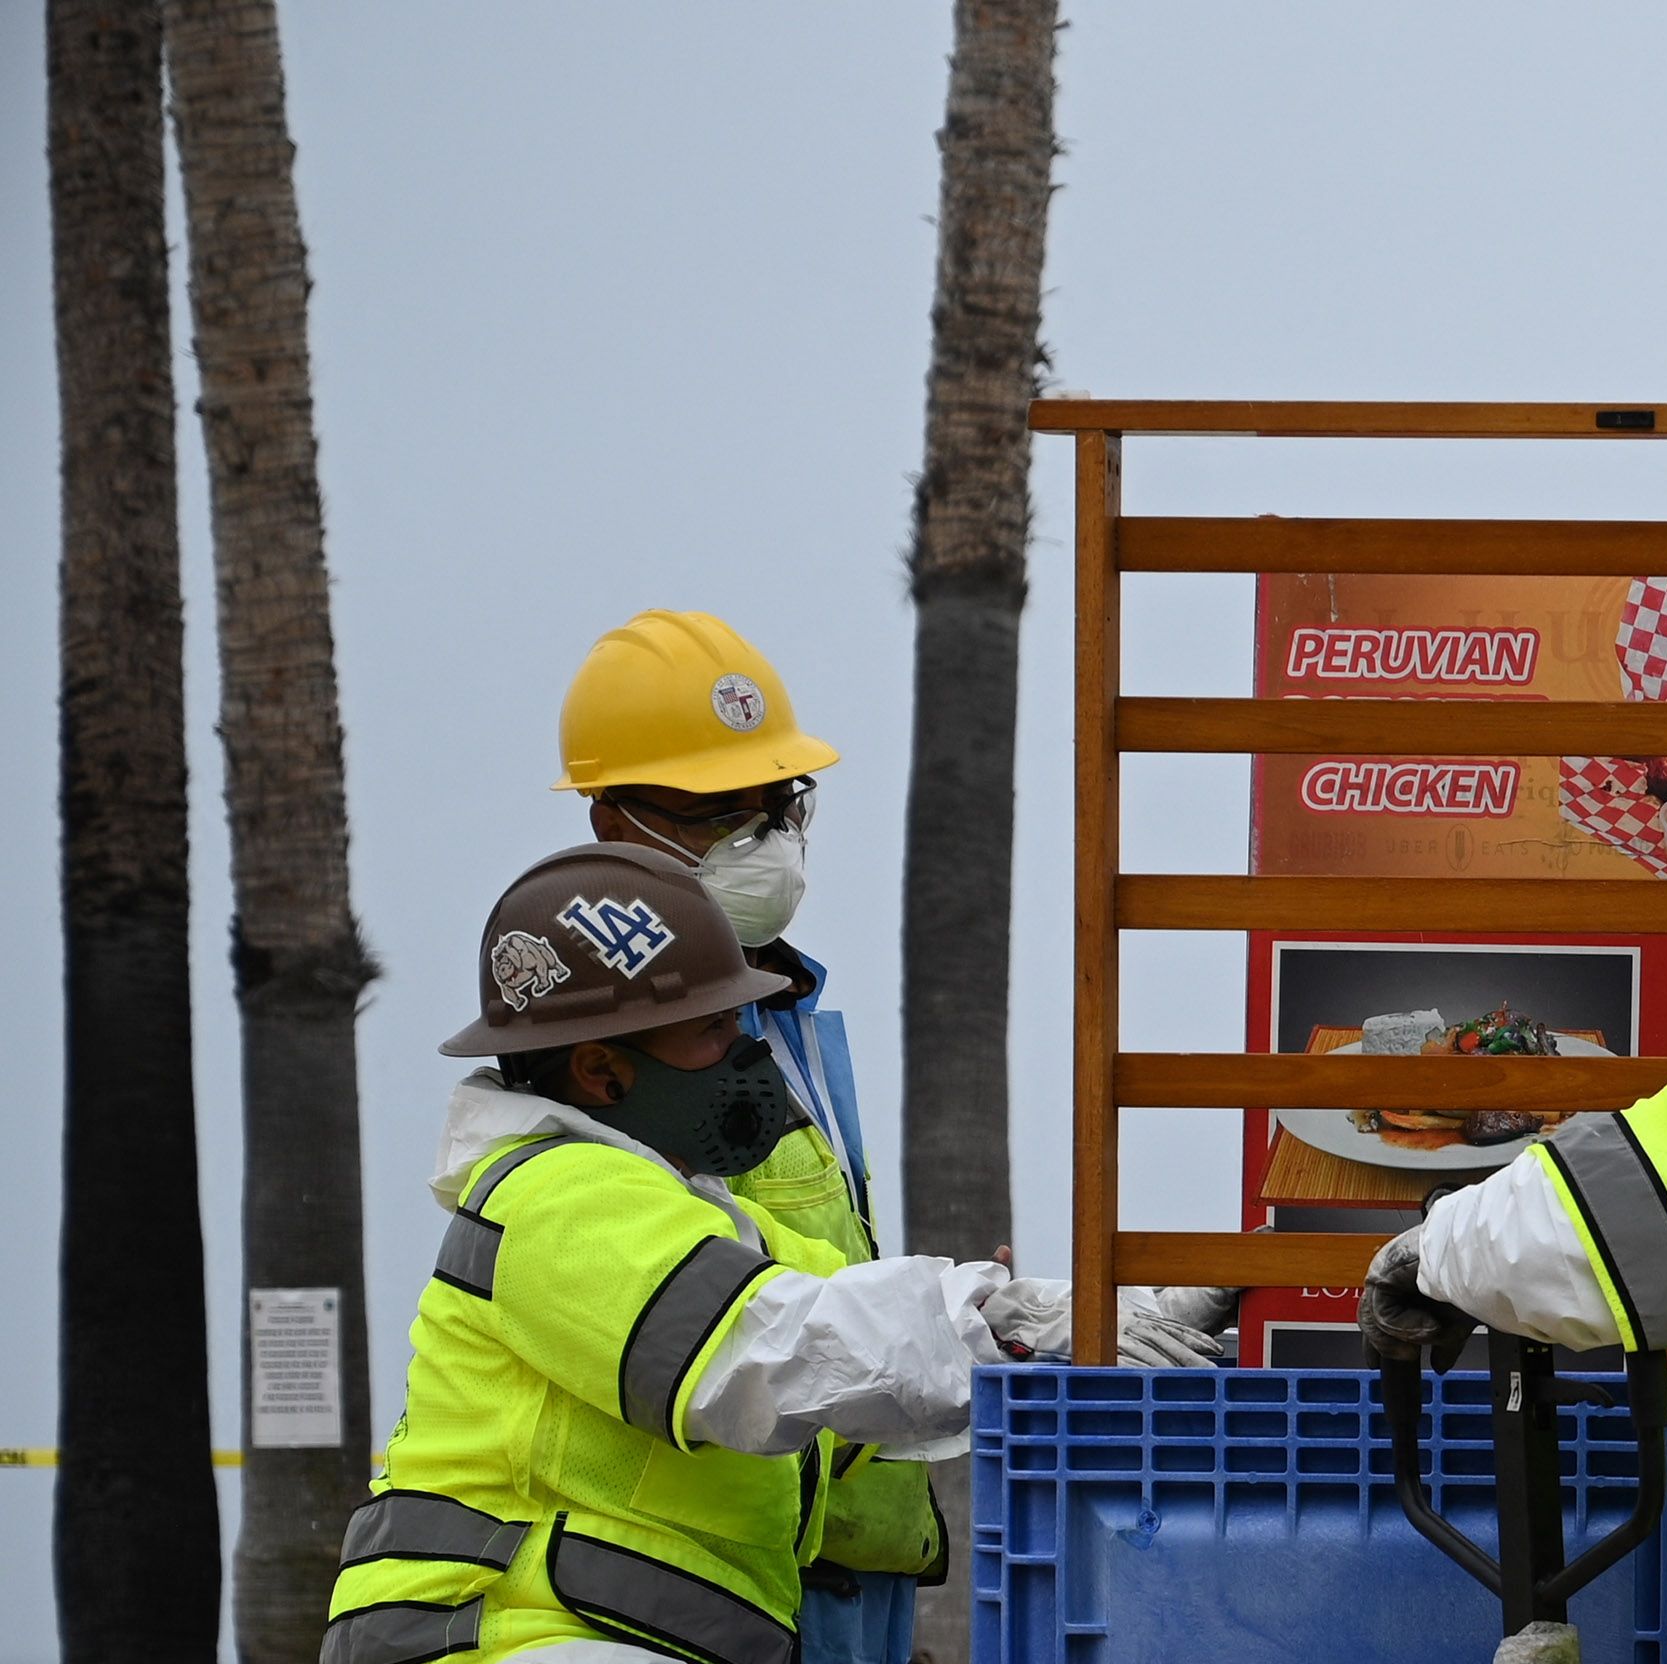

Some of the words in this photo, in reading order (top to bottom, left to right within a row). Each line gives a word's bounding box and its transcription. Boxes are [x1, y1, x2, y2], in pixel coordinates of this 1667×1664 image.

[1287, 628, 1533, 682] PERUVIAN
[1301, 762, 1516, 814] CHICKEN
[563, 903, 667, 971] LA
